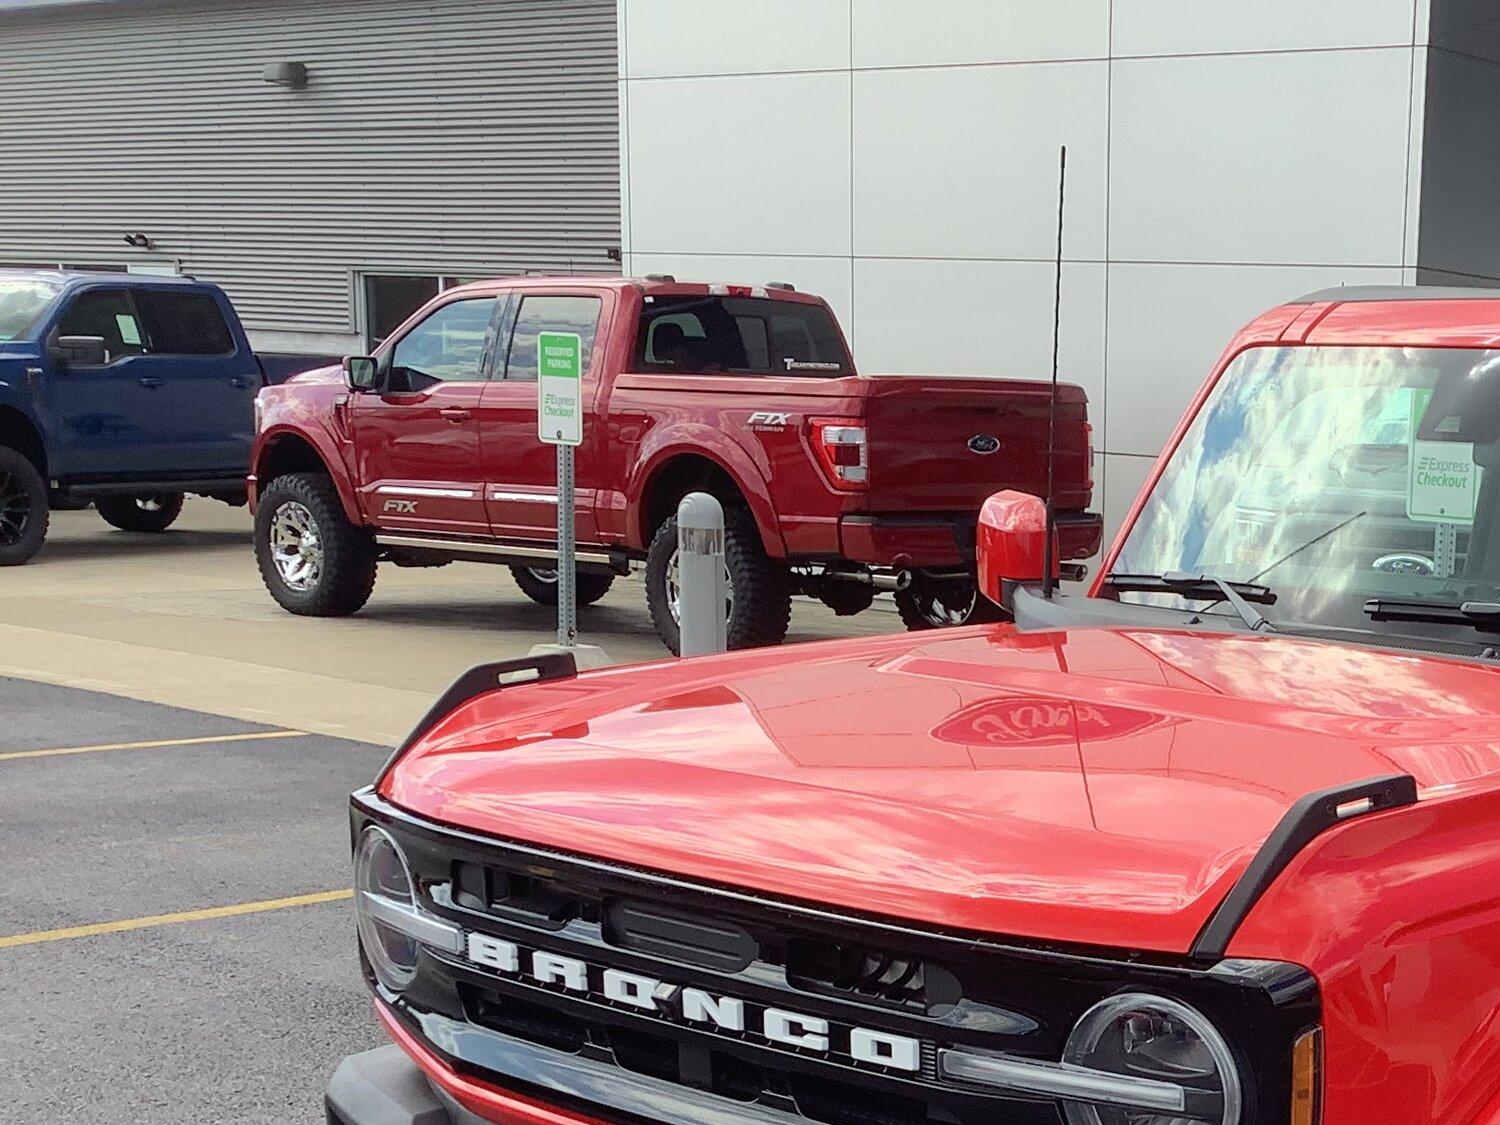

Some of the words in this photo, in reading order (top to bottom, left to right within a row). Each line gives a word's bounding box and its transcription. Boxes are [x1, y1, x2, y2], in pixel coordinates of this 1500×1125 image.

[547, 359, 572, 369] PARKING
[550, 395, 575, 406] Express
[544, 405, 574, 418] Checkout
[1429, 457, 1470, 473] Express
[1417, 471, 1468, 488] Checkout
[467, 932, 920, 1071] BRONCO
